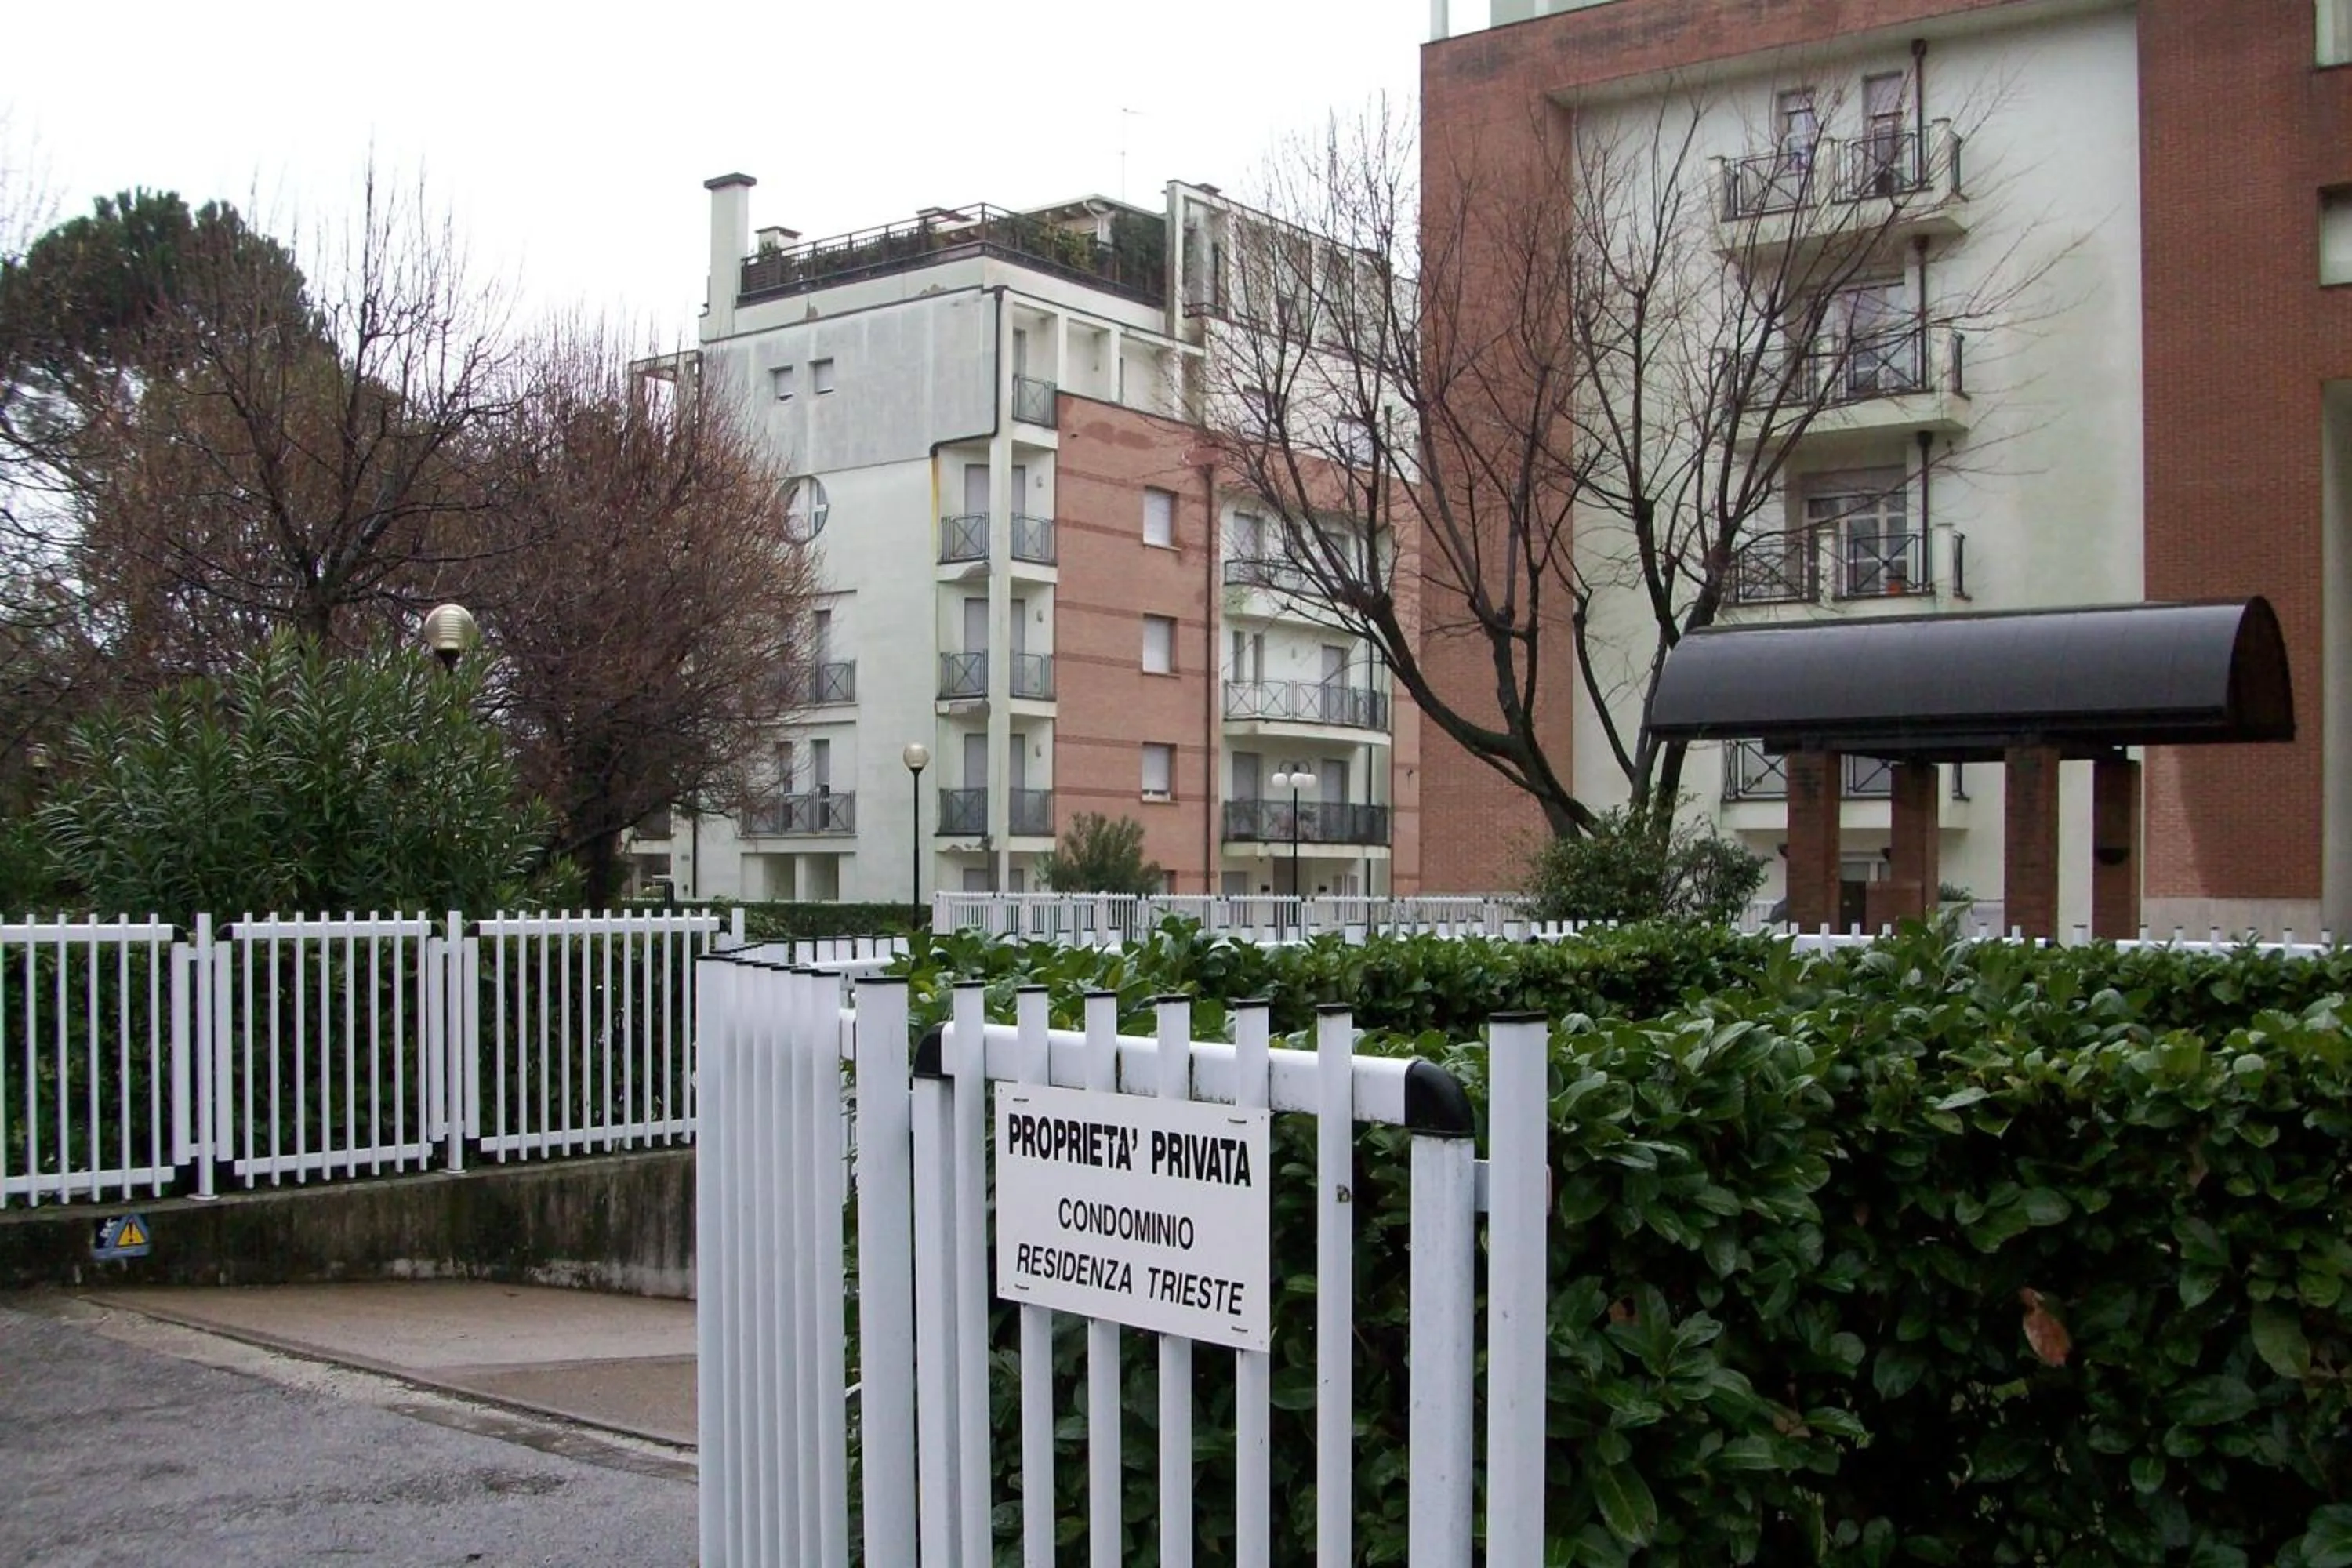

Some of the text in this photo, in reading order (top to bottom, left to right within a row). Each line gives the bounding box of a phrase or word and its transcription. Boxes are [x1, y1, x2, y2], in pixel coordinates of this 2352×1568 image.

[1008, 1112, 1252, 1188] PROPRIETA' PRIVATA
[1058, 1197, 1194, 1250] CONDOMINIO
[1017, 1243, 1245, 1316] RESIDENZA TRIESTE
